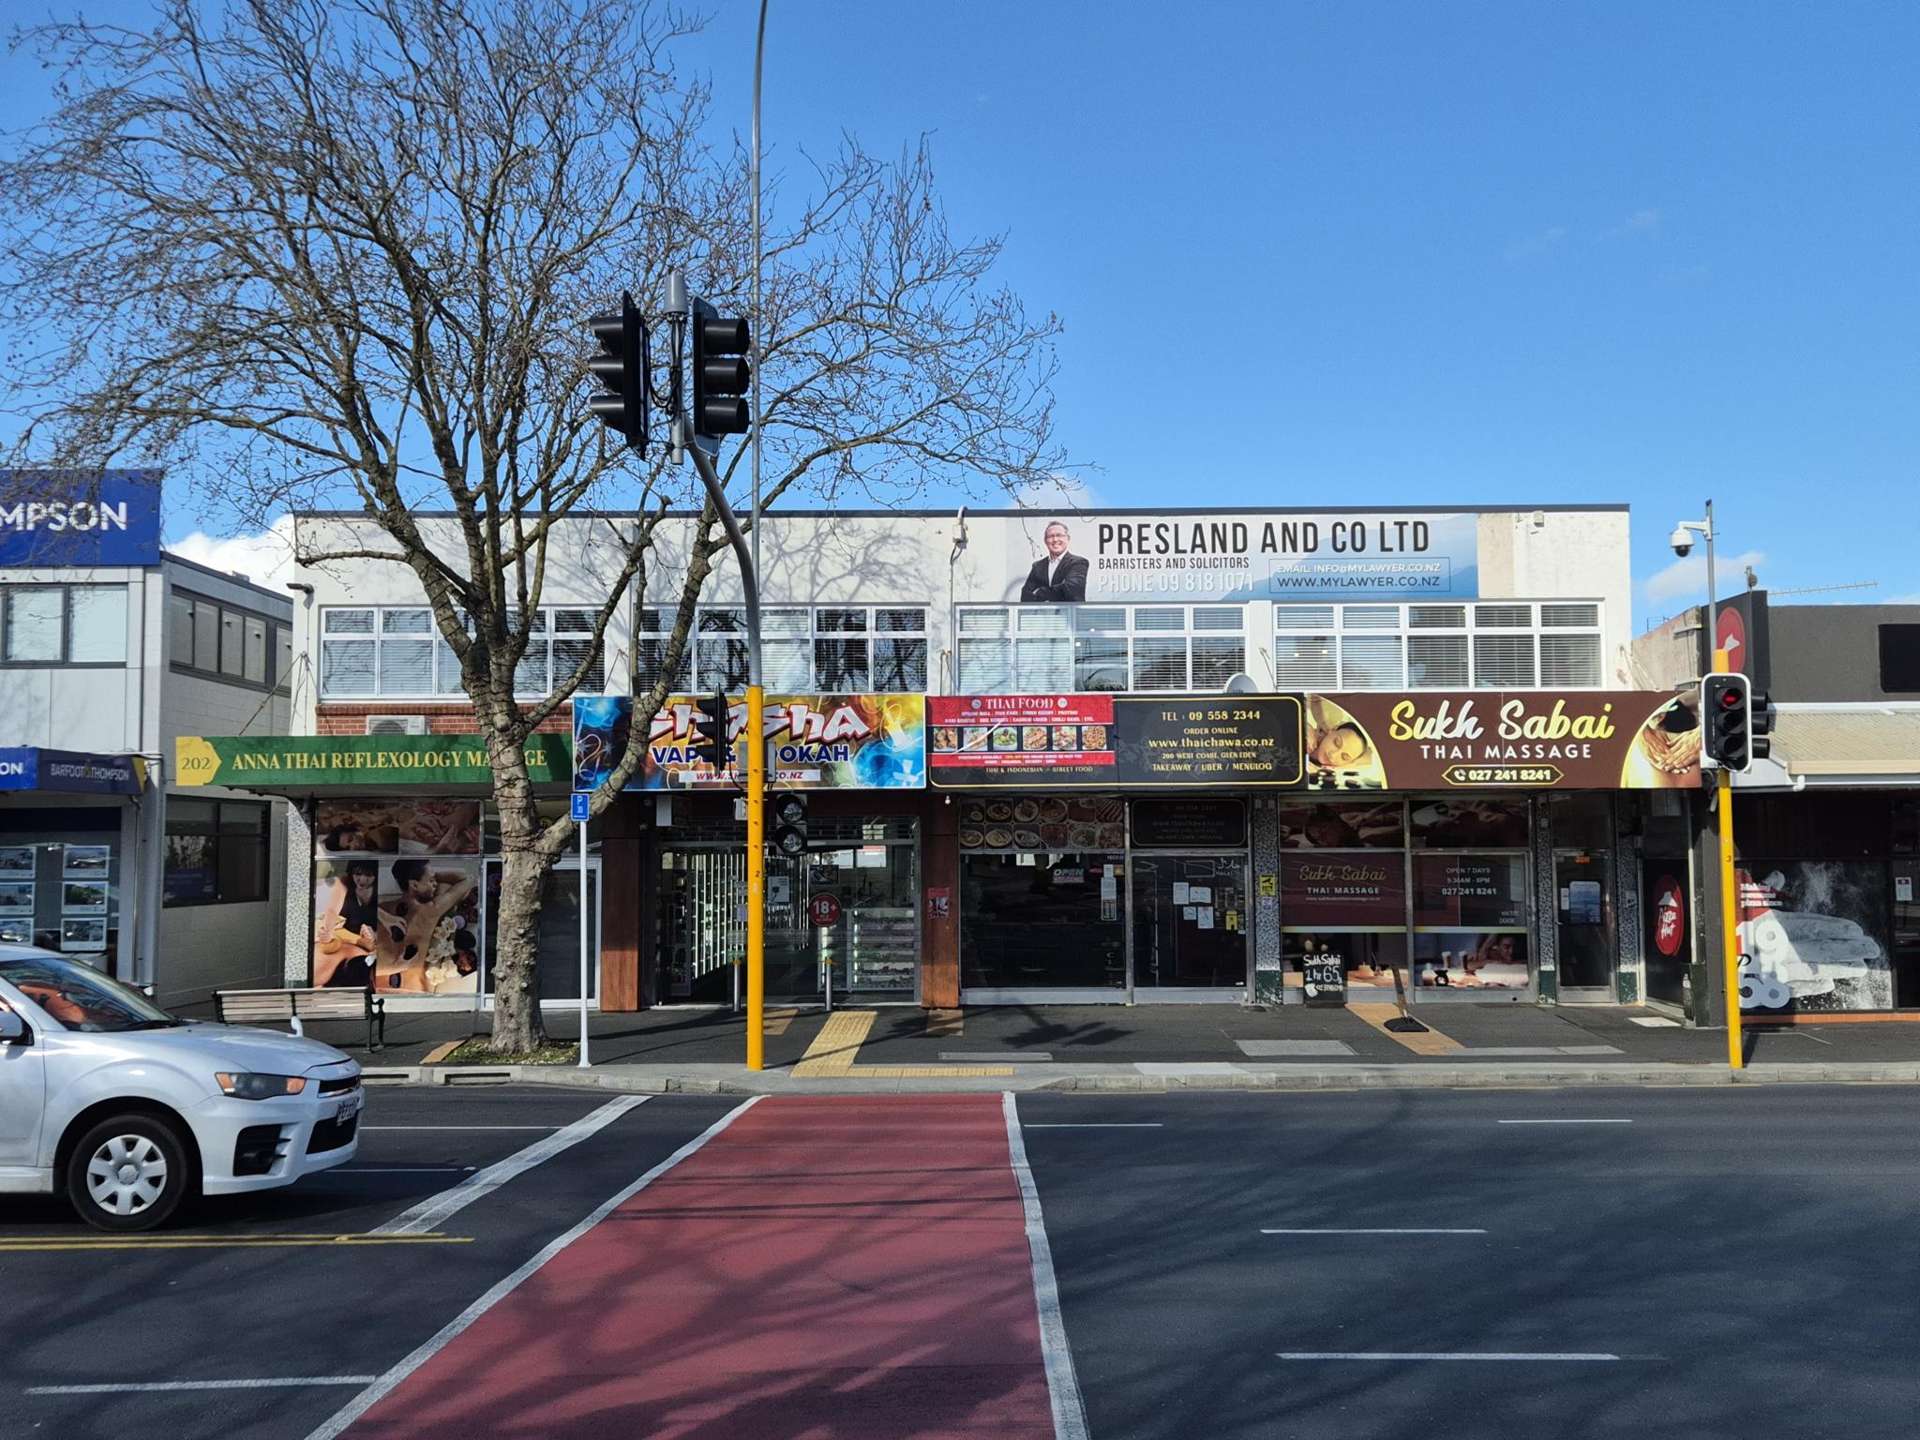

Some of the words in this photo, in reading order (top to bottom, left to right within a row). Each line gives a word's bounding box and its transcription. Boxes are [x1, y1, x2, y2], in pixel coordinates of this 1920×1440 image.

[1099, 522, 1249, 554] PRESLAND
[1261, 522, 1319, 553] AND
[1331, 521, 1367, 553] CO
[1379, 520, 1429, 552] LTD
[1098, 558, 1162, 570] BARRISTERS
[1165, 557, 1186, 569] AND
[1189, 557, 1250, 569] SOLICITORS
[1313, 562, 1441, 573] INFO@MYLAWYER.CO.NZ
[1098, 573, 1154, 593] PHONE
[1159, 573, 1180, 593] 09
[1184, 572, 1214, 593] 818
[1219, 571, 1254, 592] 1071
[1278, 576, 1441, 588] WWW.MYLAWYER.CO.NZ
[986, 698, 1015, 710] THAI
[1018, 697, 1054, 709] FOOD
[1162, 712, 1178, 721] TEL
[1188, 711, 1203, 721] 09
[1207, 711, 1229, 720] 558
[1233, 710, 1261, 720] 2344
[1389, 699, 1484, 741] Sukh
[1498, 699, 1616, 741] Sabai
[1183, 727, 1209, 735] ORDER
[1211, 727, 1239, 735] ONLINE
[1148, 737, 1275, 749] www.thaichawa.co.nz
[1420, 744, 1473, 760] THAI
[1484, 743, 1592, 759] MASSAGE
[181, 756, 212, 771] 202
[232, 753, 281, 770] ANNA
[282, 752, 327, 769] THAI
[331, 750, 463, 769] REFLEXOLOGY
[466, 750, 548, 768] MAGE
[1152, 763, 1192, 772] TAKEAWAY
[1201, 763, 1223, 771] UBER
[1232, 762, 1273, 771] MENULOG
[1468, 769, 1493, 782] 027
[1494, 769, 1518, 782] 241
[1520, 769, 1551, 782] 8241
[1299, 864, 1337, 881] Sukh
[1341, 864, 1387, 881] Sabai
[1306, 886, 1329, 895] THAI
[1333, 886, 1380, 895] MASSAGE
[1441, 887, 1457, 896] 027
[1457, 887, 1474, 896] 241
[1476, 887, 1497, 896] 8241
